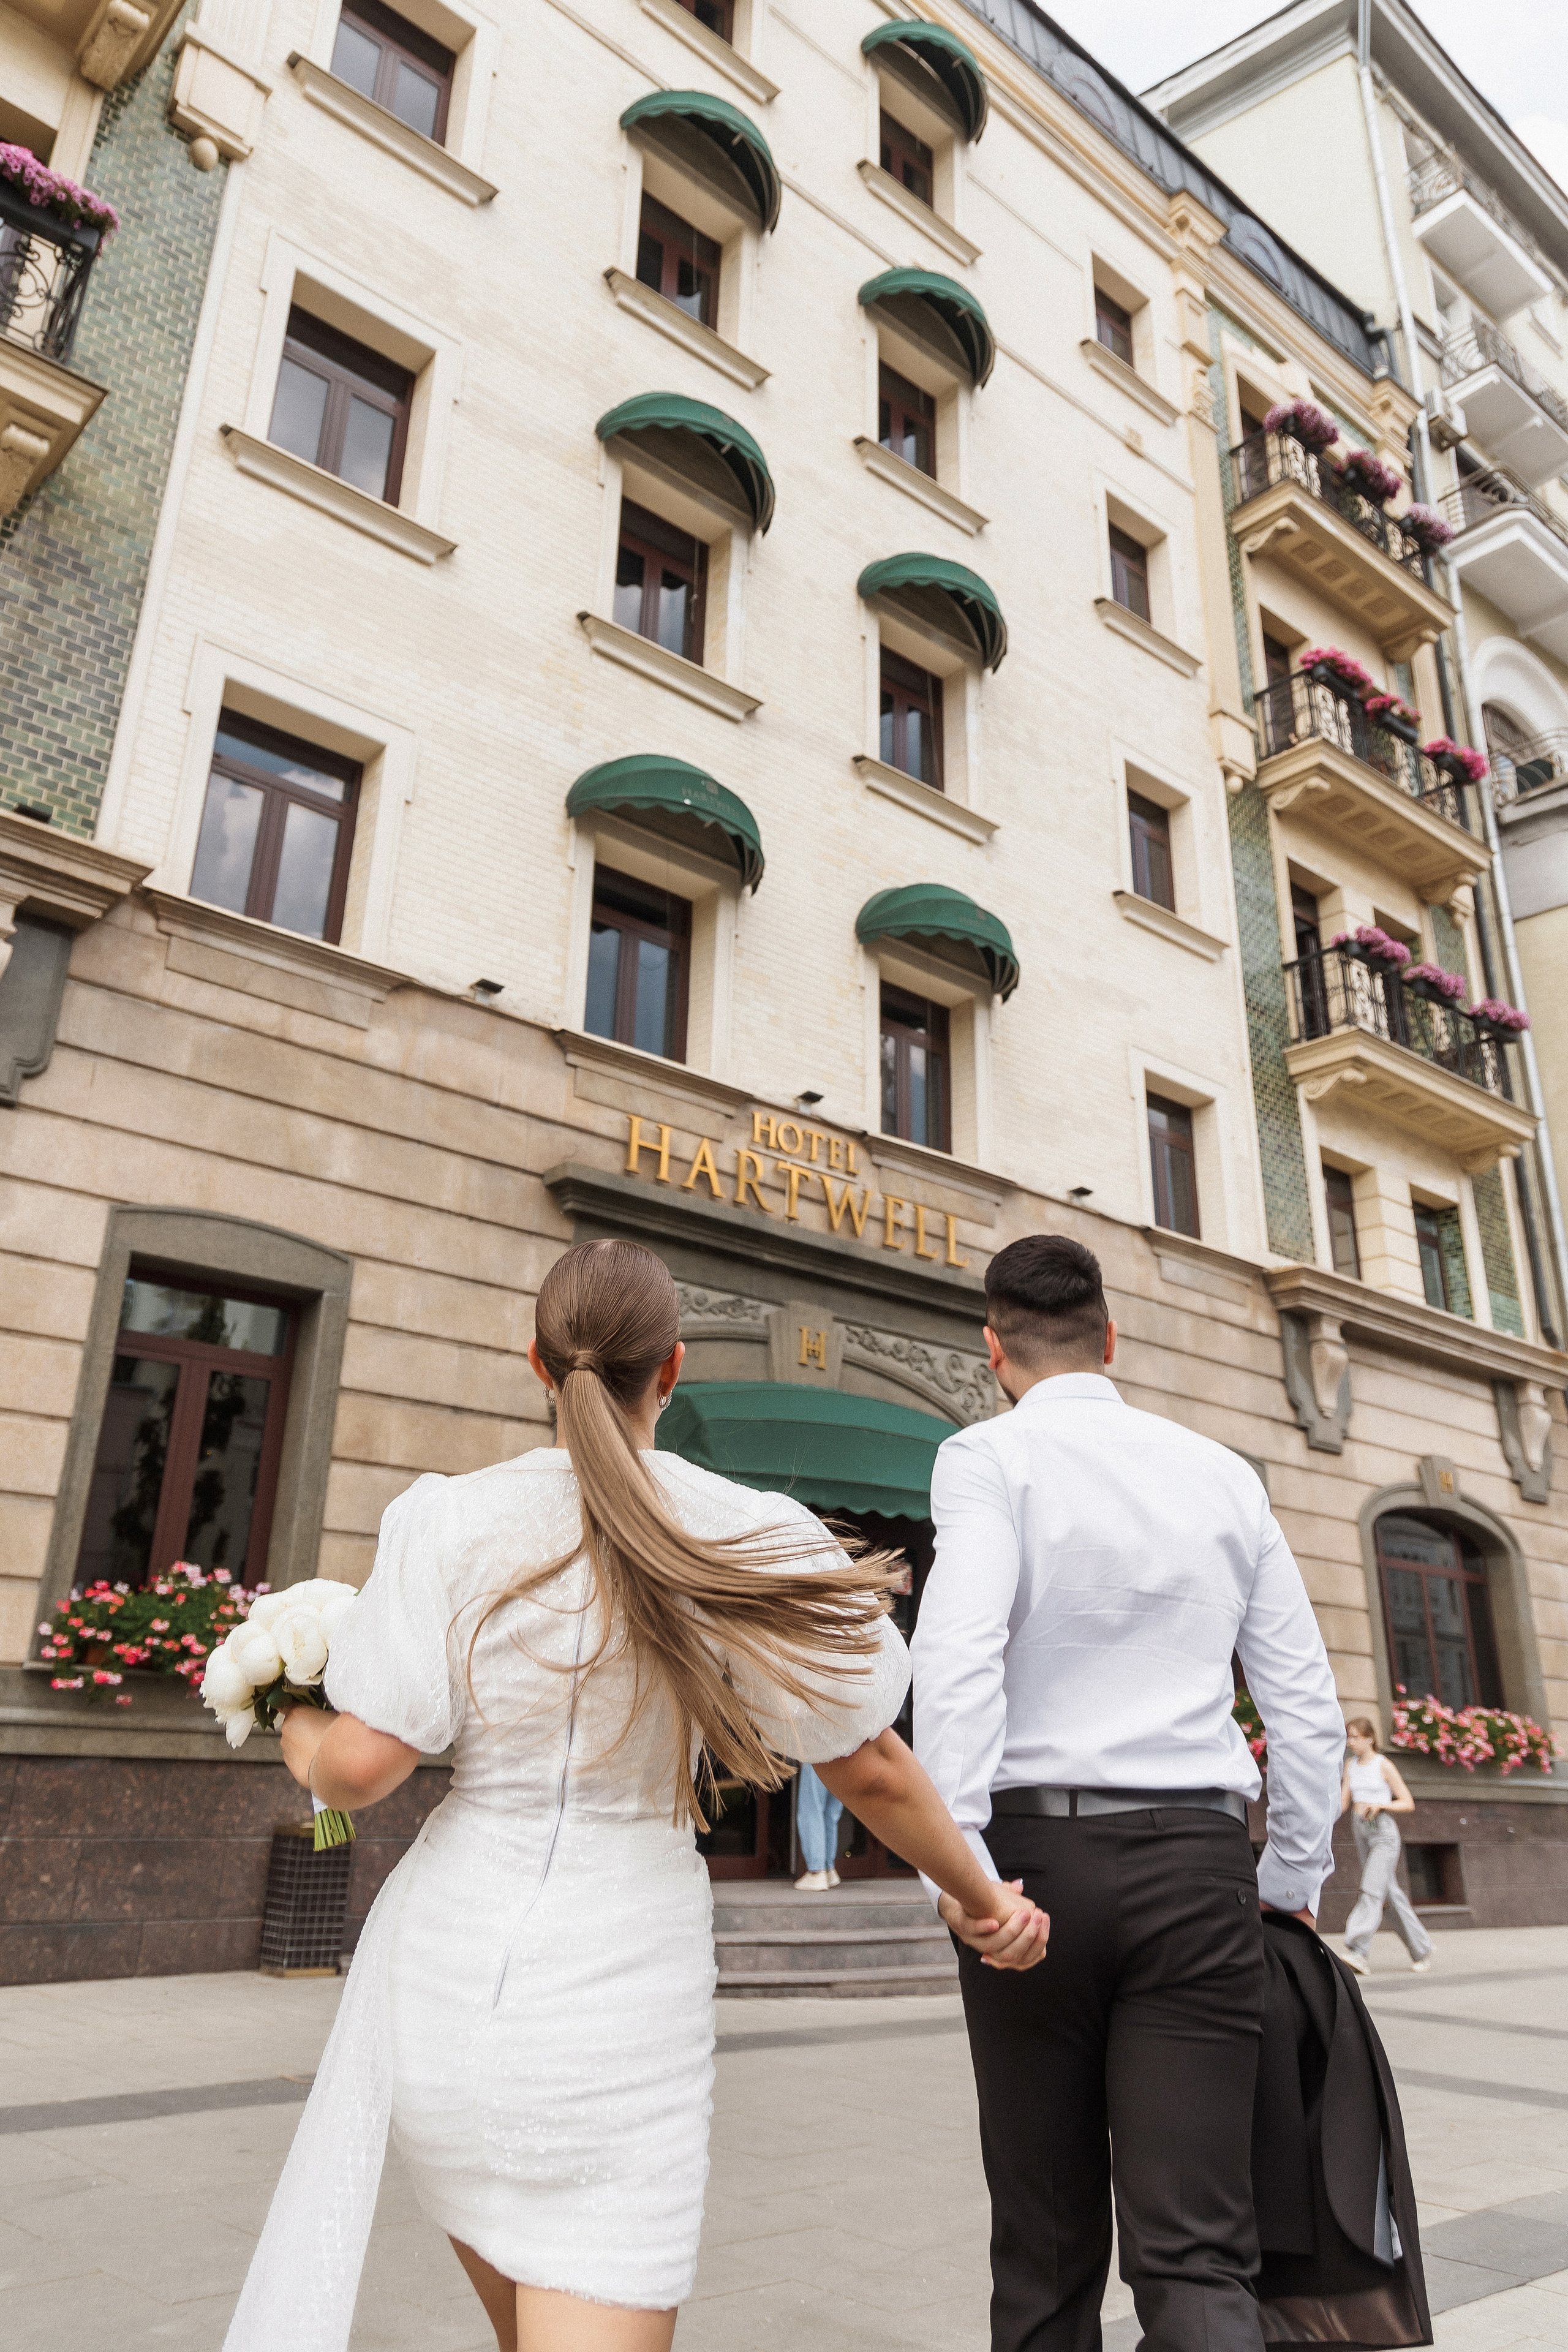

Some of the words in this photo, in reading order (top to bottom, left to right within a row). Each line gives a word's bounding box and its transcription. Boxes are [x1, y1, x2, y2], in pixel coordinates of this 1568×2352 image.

[752, 1111, 859, 1174] HOTEL
[625, 1114, 970, 1267] HARTWELL
[799, 1326, 826, 1370] H
